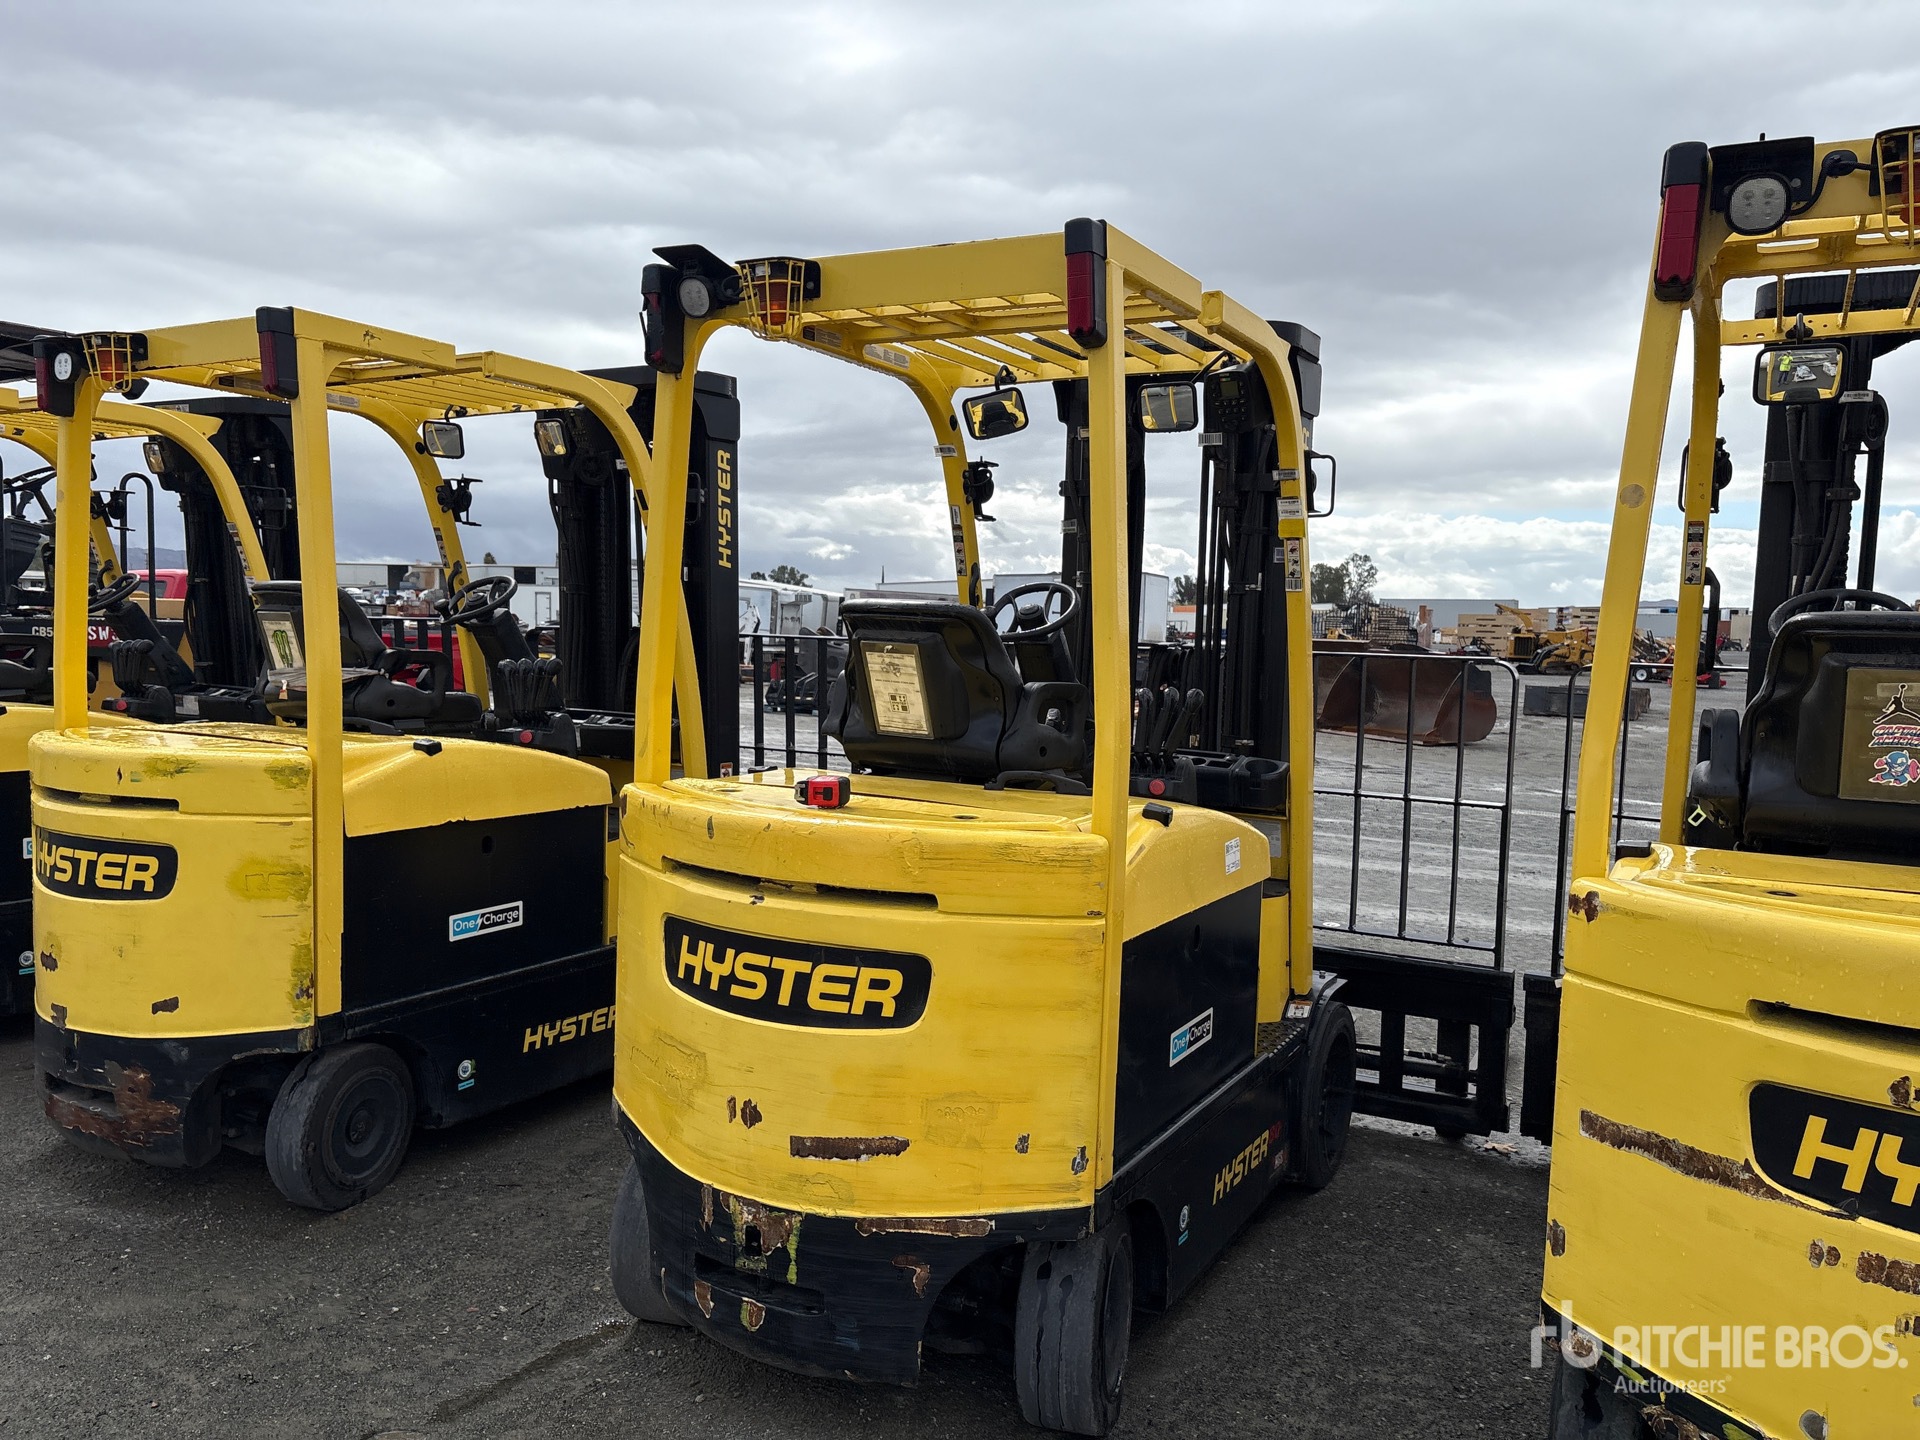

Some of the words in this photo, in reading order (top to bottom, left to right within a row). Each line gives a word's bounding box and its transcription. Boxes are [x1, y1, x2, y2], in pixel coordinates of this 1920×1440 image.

[717, 449, 731, 569] HYSTER
[38, 841, 159, 892] HYSTER
[677, 934, 904, 1018] HYSTER
[1212, 1129, 1269, 1206] HYSTER
